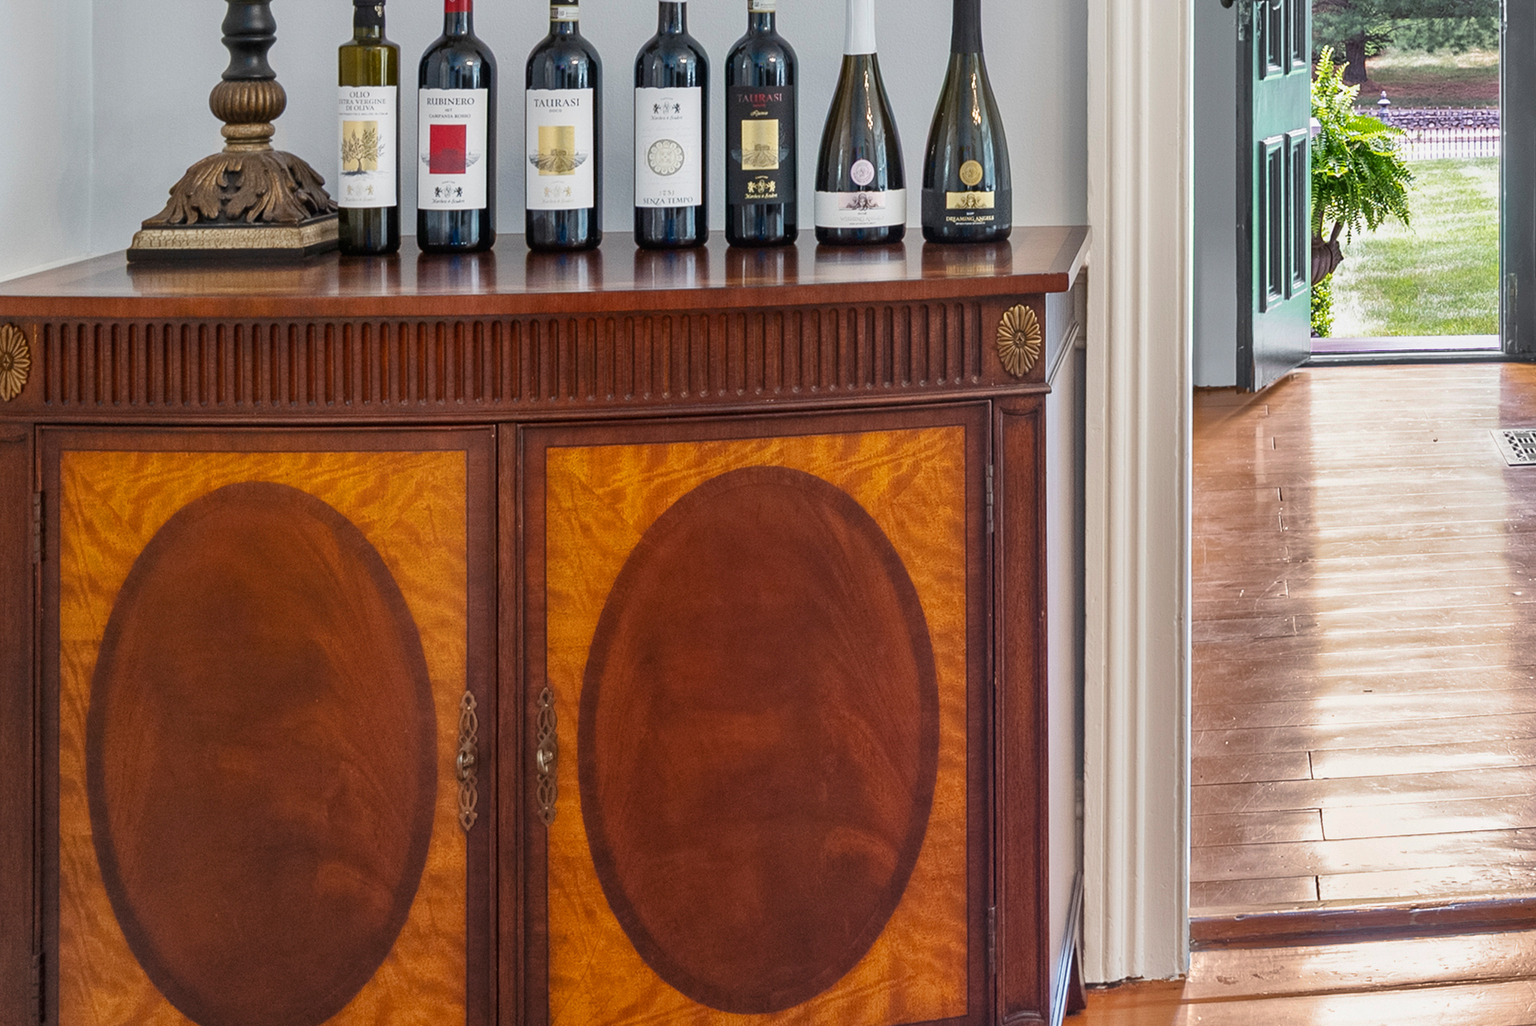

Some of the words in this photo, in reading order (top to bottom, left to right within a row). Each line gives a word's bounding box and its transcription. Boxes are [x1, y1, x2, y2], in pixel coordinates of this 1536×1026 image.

[426, 97, 475, 106] RUBINERO
[737, 92, 783, 103] TAURASI
[533, 98, 580, 108] TAURASI
[643, 197, 666, 206] SENZA
[668, 196, 694, 204] TEMPO
